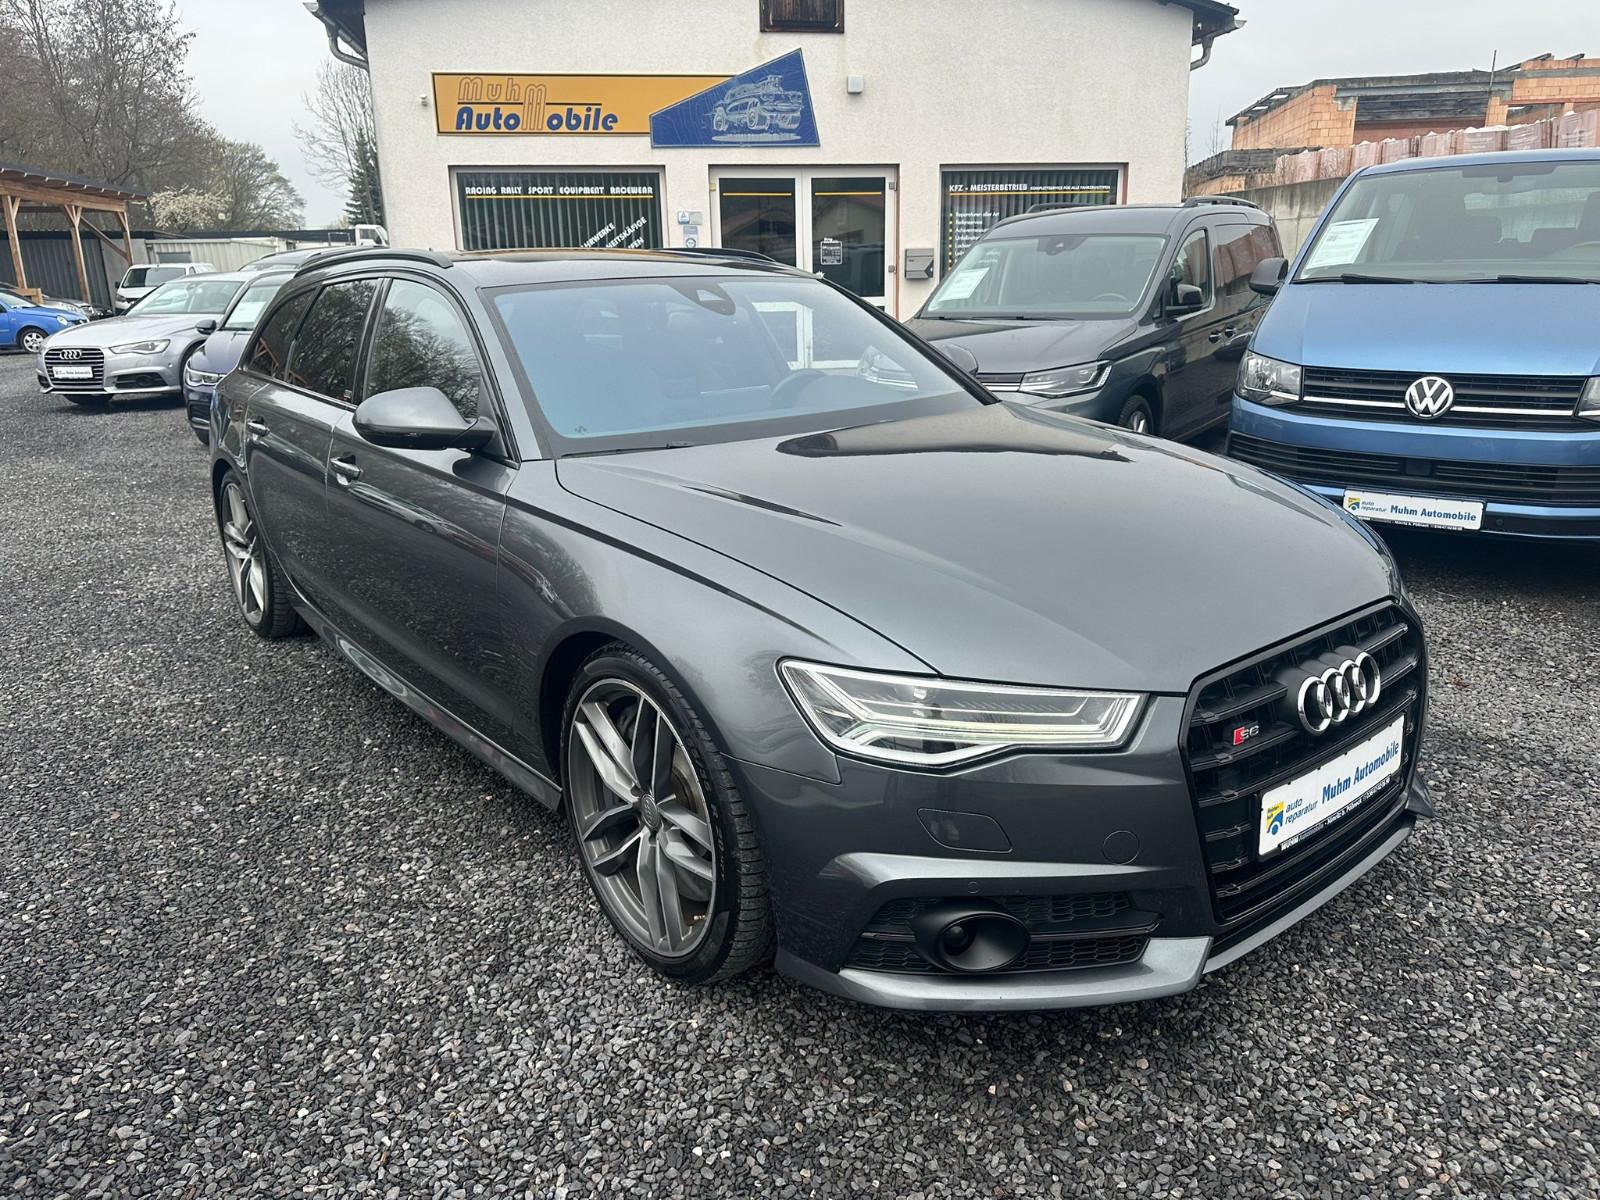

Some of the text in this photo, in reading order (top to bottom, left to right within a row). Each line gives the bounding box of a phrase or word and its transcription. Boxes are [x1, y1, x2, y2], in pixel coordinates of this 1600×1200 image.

[465, 186, 653, 195] RACING RALLY SPORT EQUIPMENT RACEWEAR
[949, 184, 963, 192] KFZ
[970, 183, 1028, 191] MEISTERBETRIEB
[580, 222, 616, 248] HRWERKE
[605, 216, 647, 248] HEITSKÄFIGE
[1390, 504, 1477, 521] Muhm Automobile
[1322, 777, 1351, 805] Muhm
[1353, 740, 1400, 785] Automobile
[1285, 798, 1303, 813] auto
[1285, 800, 1319, 824] reparatur
